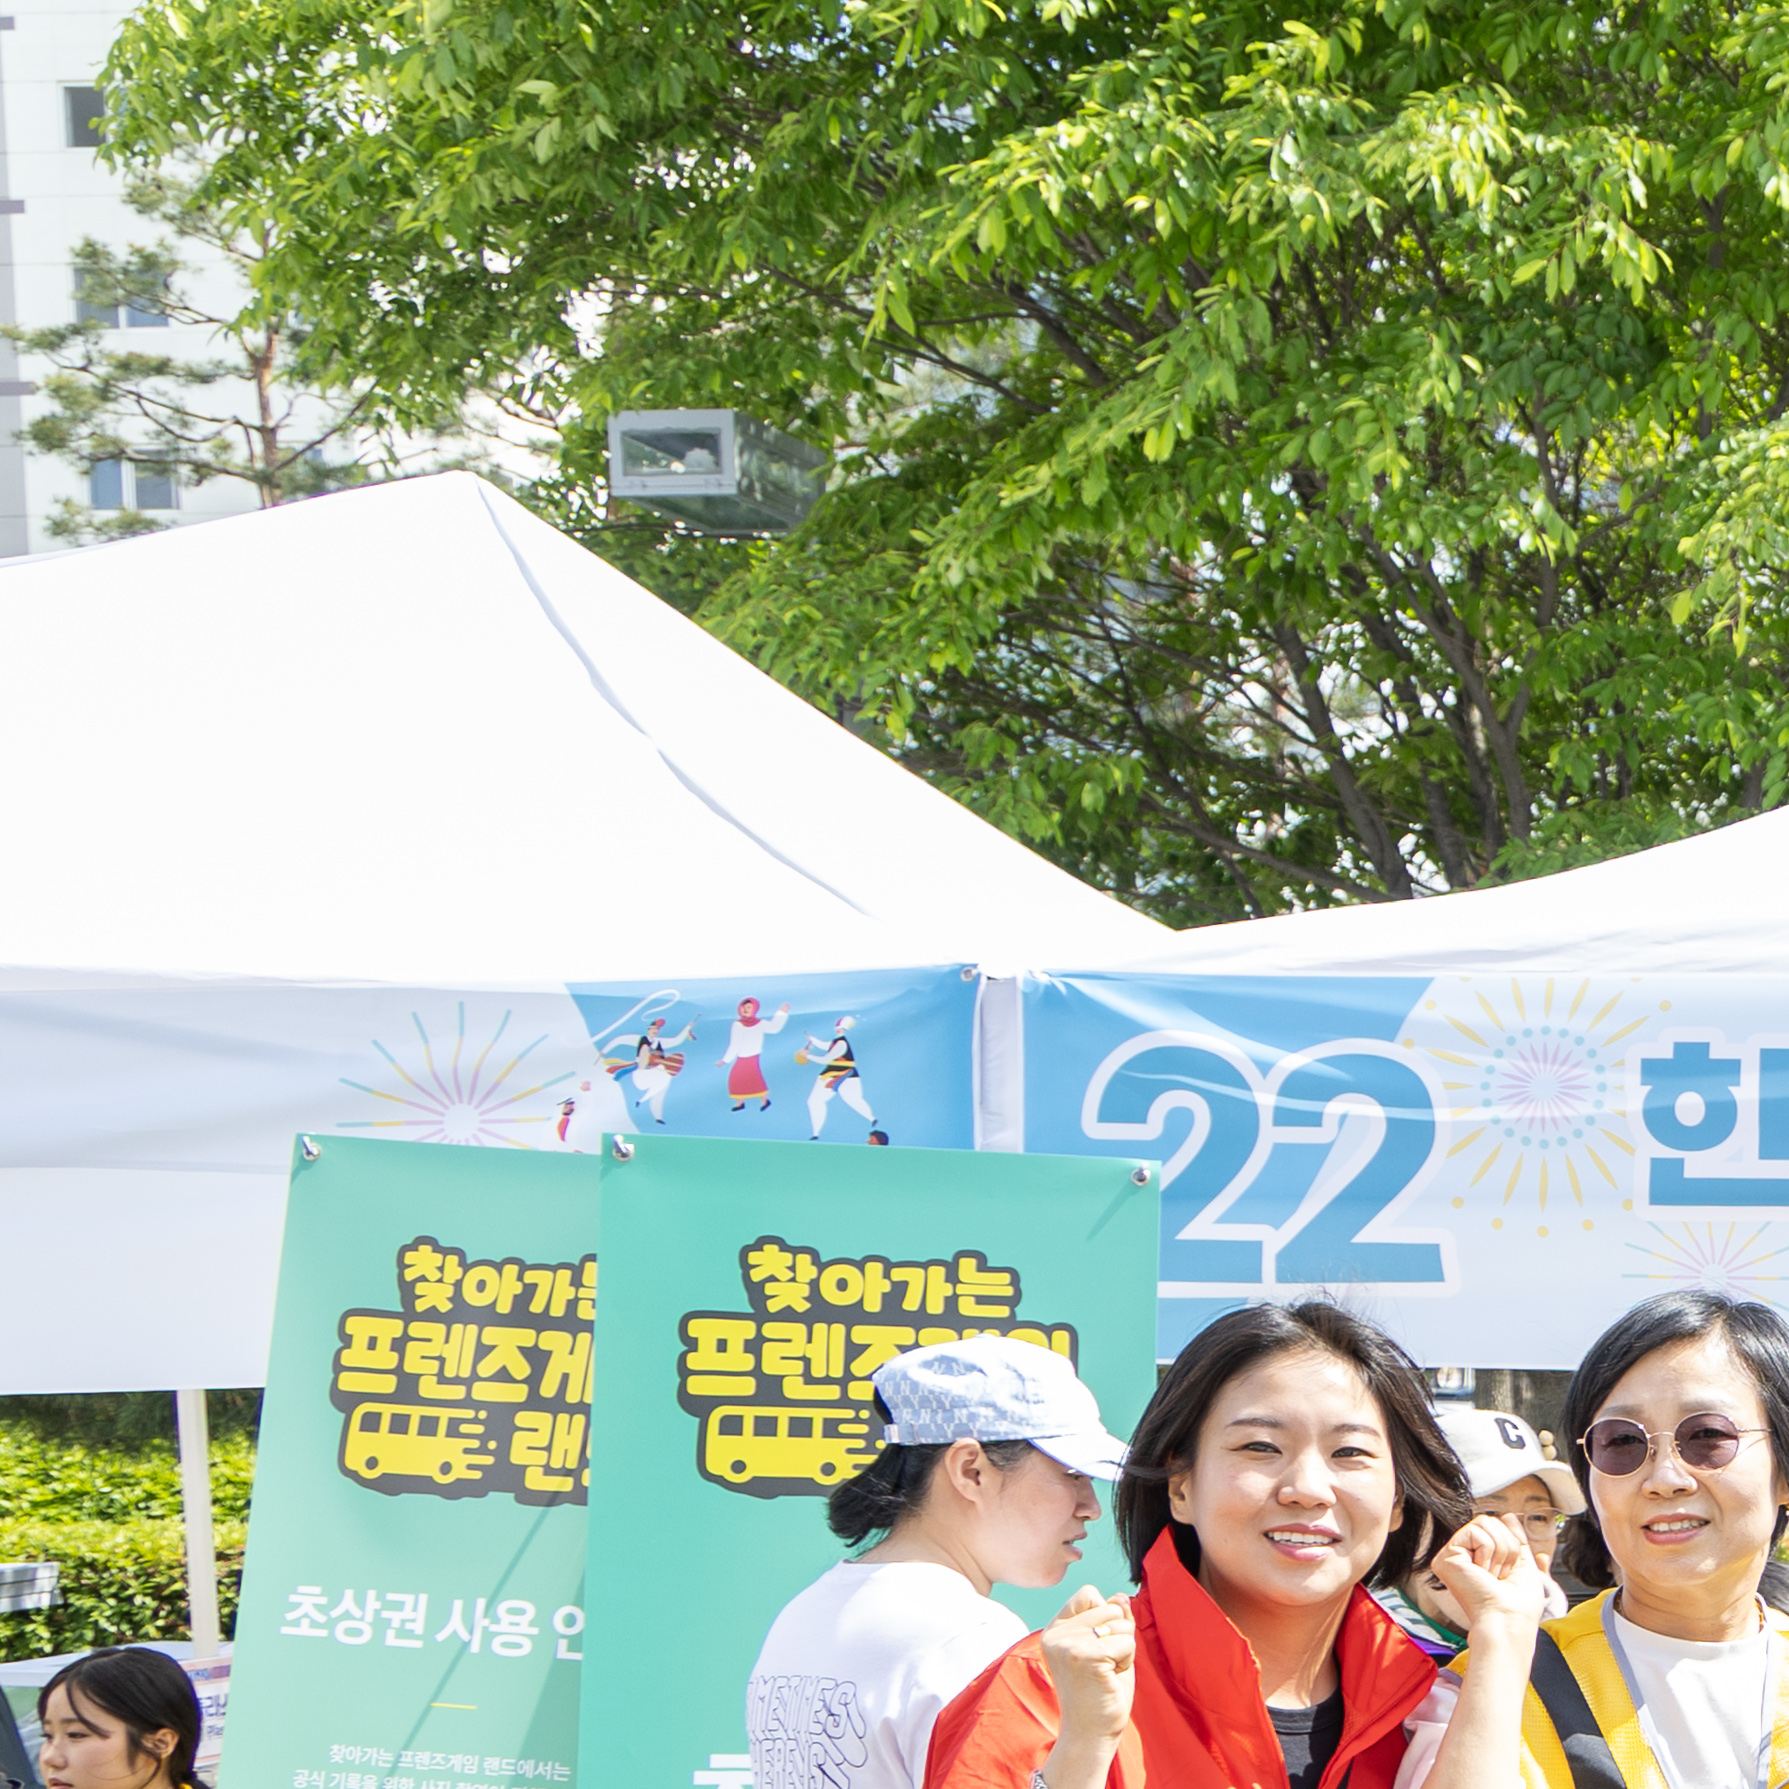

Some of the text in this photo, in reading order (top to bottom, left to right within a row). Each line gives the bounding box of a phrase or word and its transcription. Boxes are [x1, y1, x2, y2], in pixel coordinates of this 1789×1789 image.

[1083, 1032, 1458, 1296] 22
[747, 1243, 1014, 1319] 찾아가는
[509, 1410, 592, 1492] 랜
[1494, 1417, 1526, 1449] C
[280, 1586, 428, 1649] 초상권
[435, 1598, 539, 1657] 사용
[293, 1769, 326, 1789] 공식
[329, 1744, 571, 1781] 찾아가는 프렌즈게임 랜드에서는
